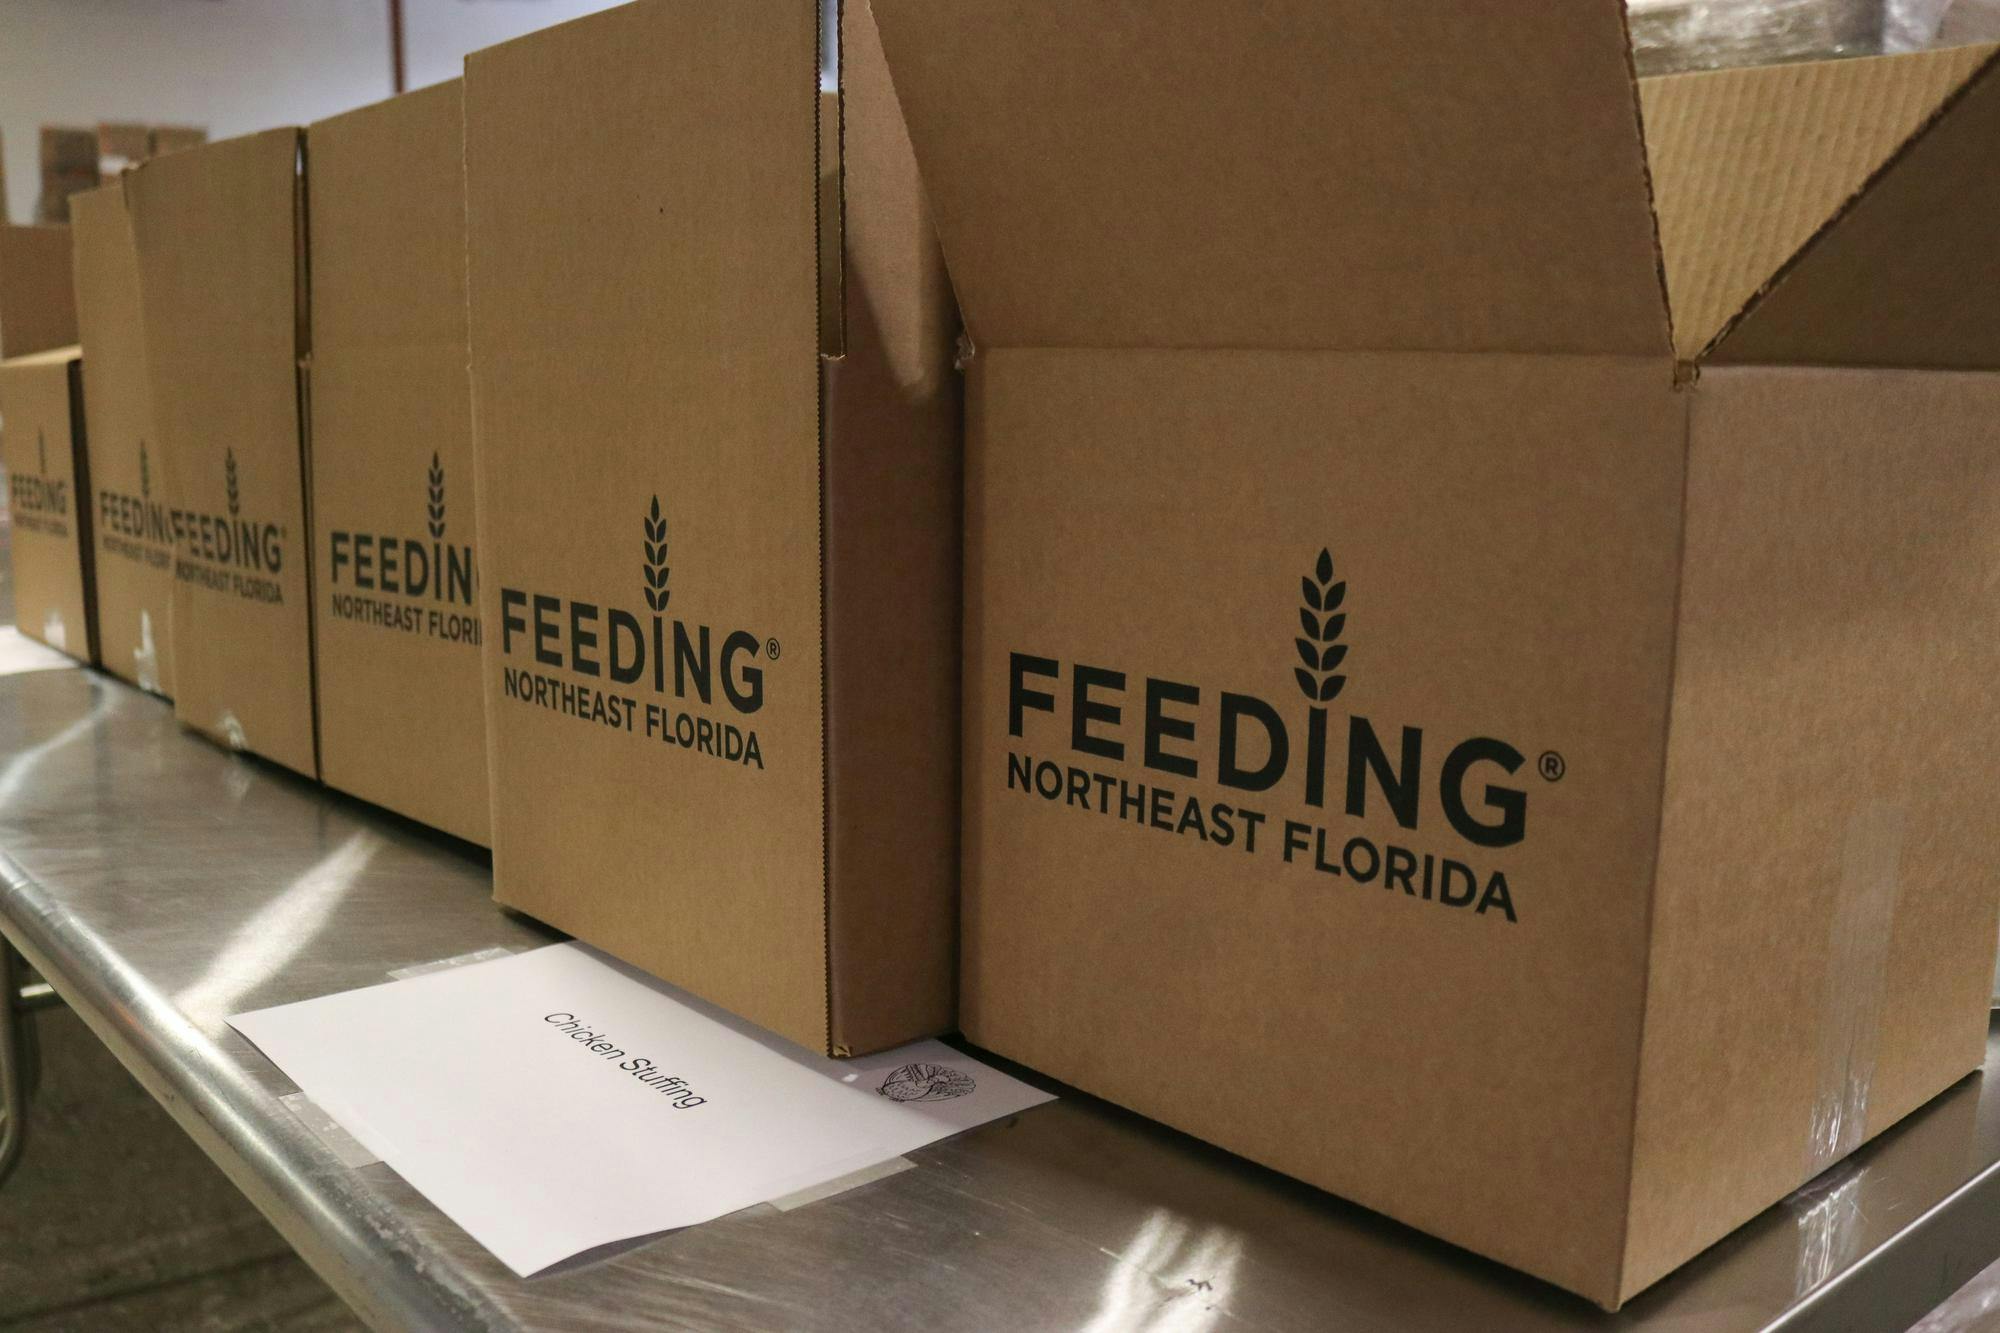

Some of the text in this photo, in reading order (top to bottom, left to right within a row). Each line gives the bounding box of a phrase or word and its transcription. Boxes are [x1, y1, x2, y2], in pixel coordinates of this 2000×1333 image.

[330, 530, 480, 607] FEEDIN
[332, 593, 482, 647] NORTHEAST FLORI
[504, 669, 765, 770] NORTHEAST FLORIDA
[1007, 752, 1518, 923] NORTHEAST FLORIDA
[544, 1012, 708, 1110] Chicken Stuffing
